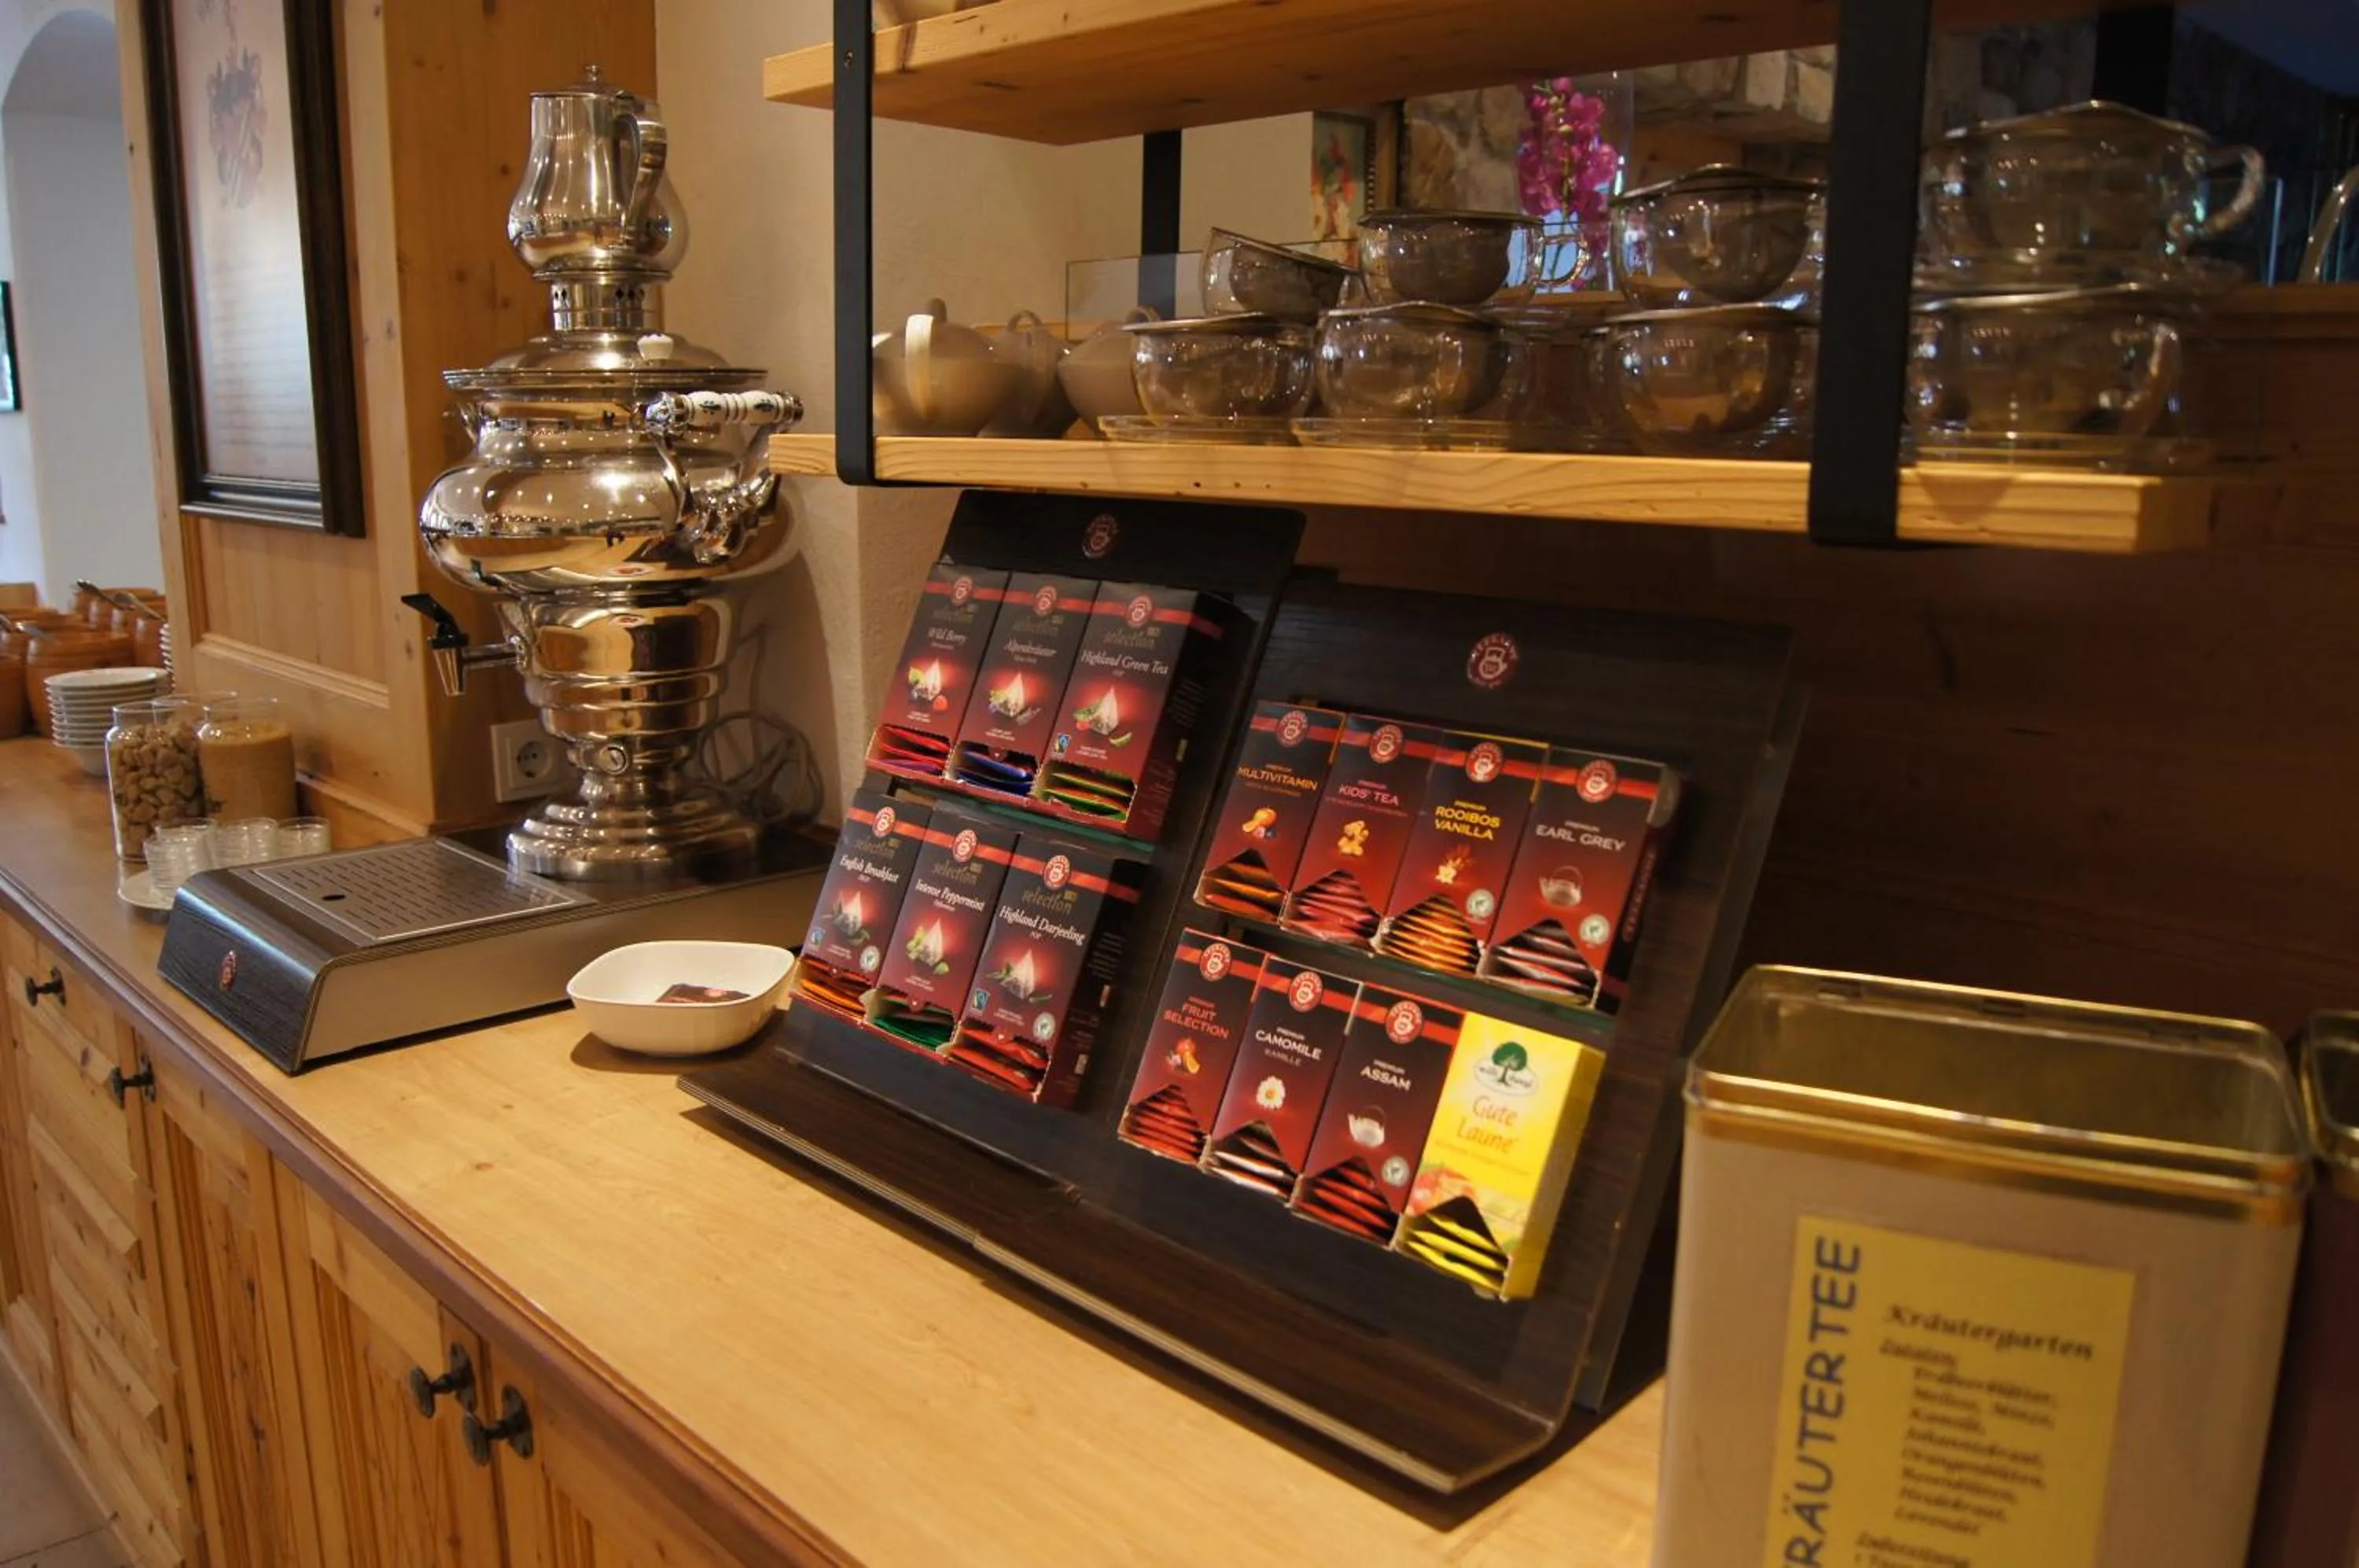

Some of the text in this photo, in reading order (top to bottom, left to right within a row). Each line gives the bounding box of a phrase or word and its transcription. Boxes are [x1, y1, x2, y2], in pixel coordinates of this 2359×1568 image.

[1081, 650, 1168, 674] Highland Green Tea
[1236, 767, 1319, 791] MULTIVITAMIN
[1373, 791, 1400, 806] TEA
[1434, 805, 1500, 828] ROOIBOS
[1434, 818, 1494, 841] VANILLA
[1535, 824, 1627, 852] EARL GREY
[840, 854, 900, 884] English Breakfast
[915, 878, 941, 897] Intense
[941, 886, 985, 912] Peppermint
[999, 905, 1086, 946] Highland Darjeeling
[1163, 1009, 1230, 1039] SELECTION
[1182, 1002, 1218, 1021] FRUIT
[1255, 1029, 1323, 1060] CAMOMILE
[1360, 1065, 1412, 1091] ASSAM
[1472, 1094, 1519, 1127] Gute
[1456, 1115, 1515, 1154] Laune
[1884, 1303, 2093, 1362] Kräutergarten
[1780, 1235, 1861, 1568] RÄUTERTEE
